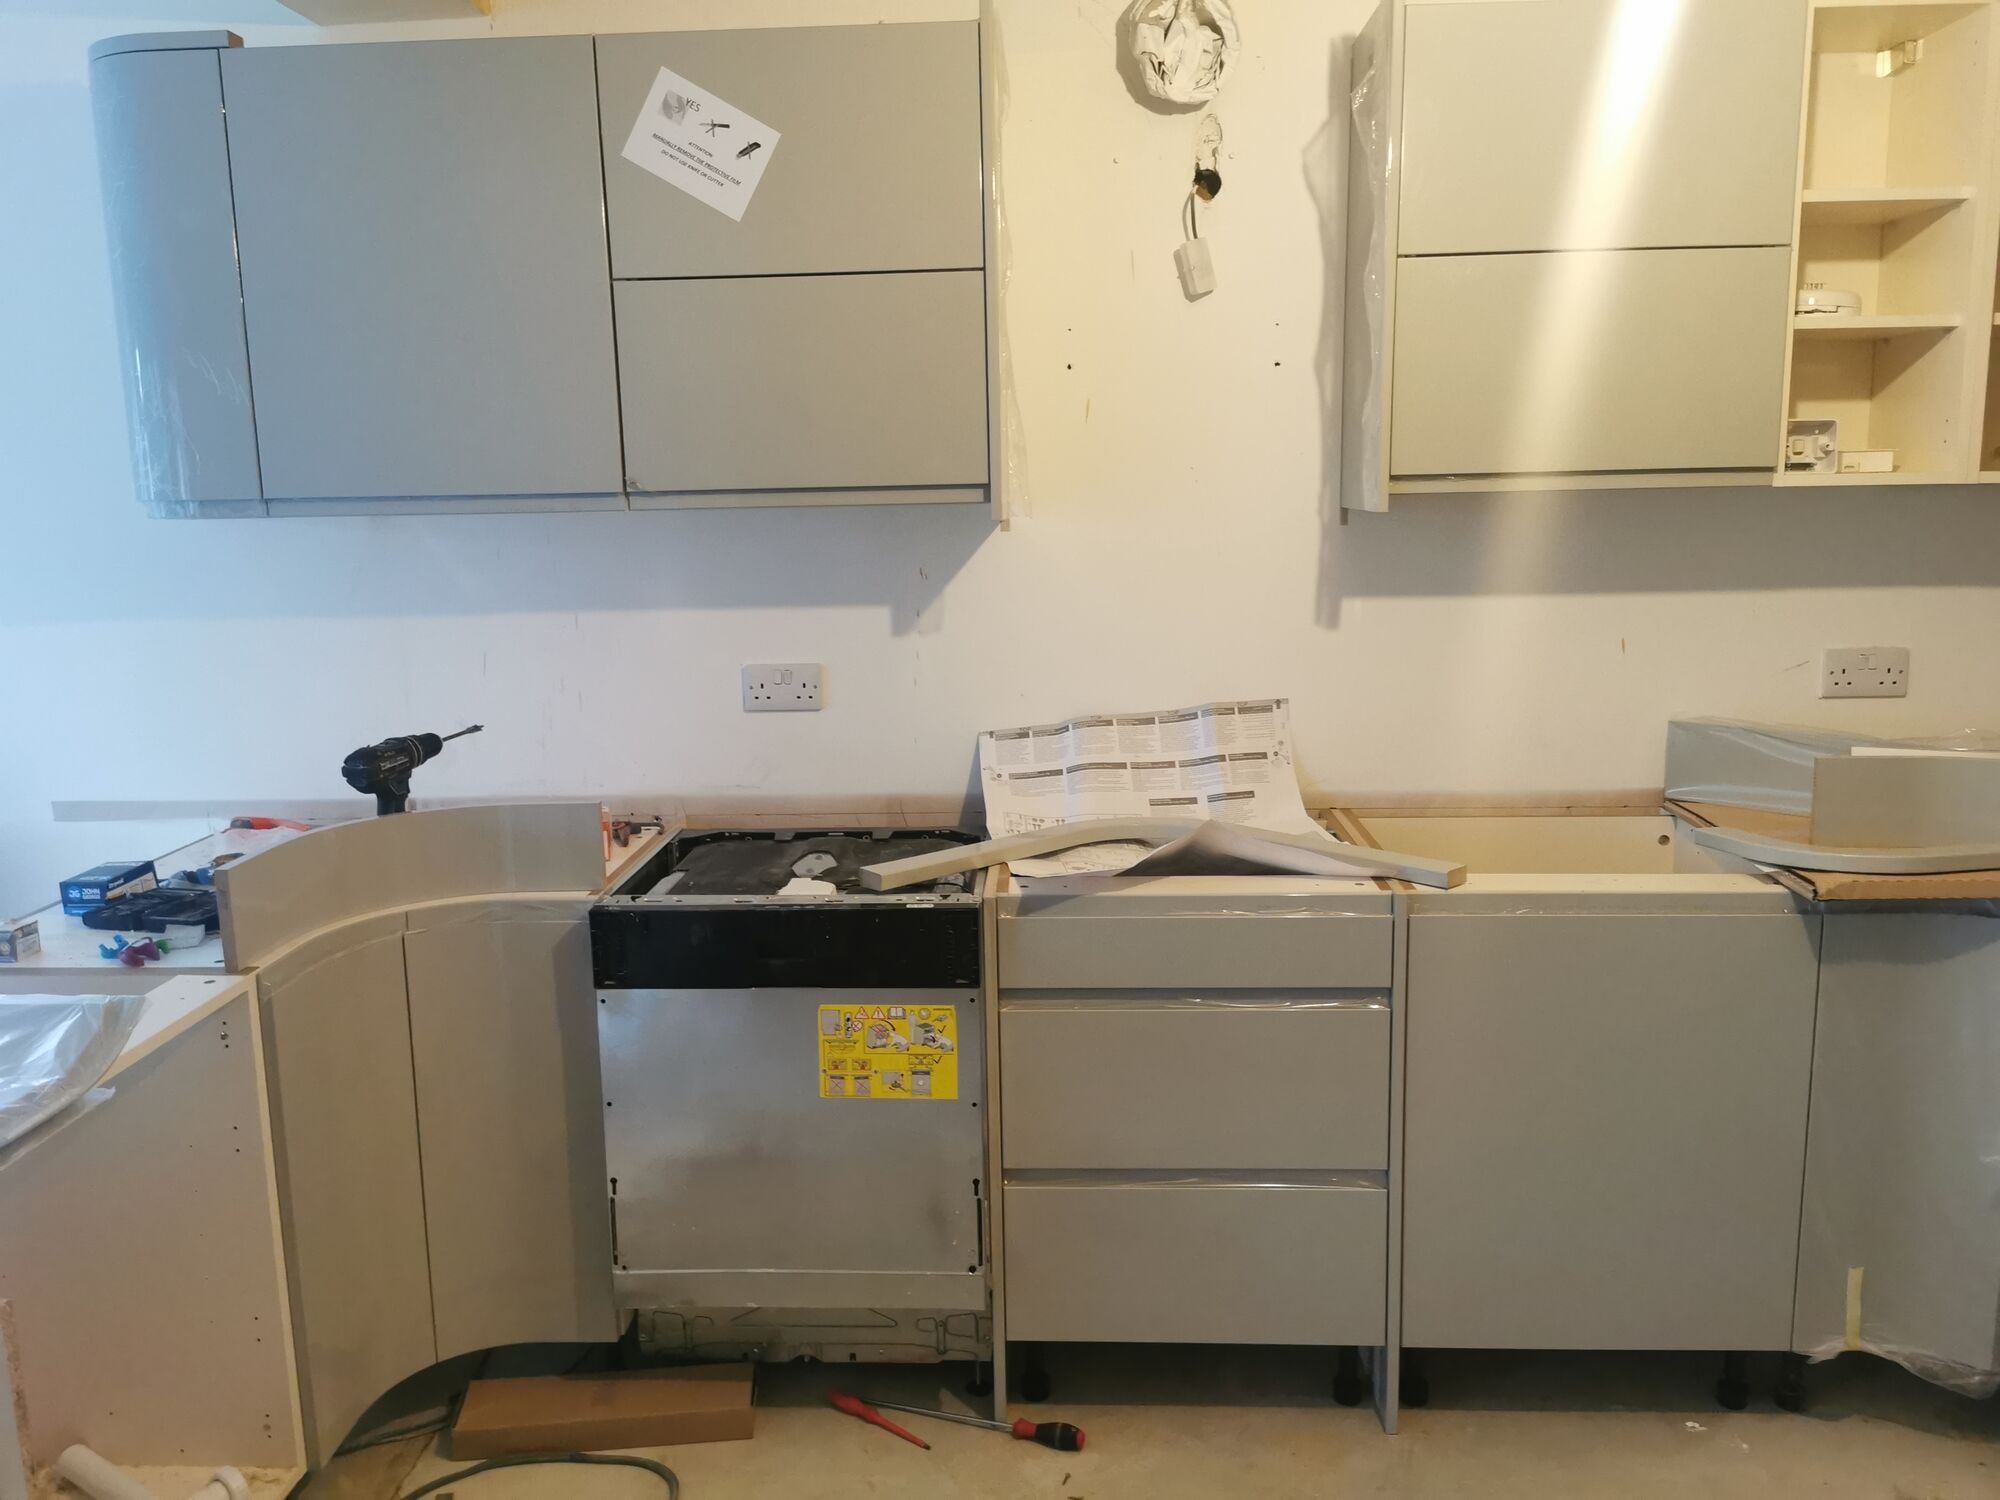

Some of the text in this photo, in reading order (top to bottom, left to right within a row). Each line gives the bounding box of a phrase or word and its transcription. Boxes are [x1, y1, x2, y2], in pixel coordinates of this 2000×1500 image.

[685, 97, 702, 113] YES
[688, 142, 713, 158] ATTENTION
[668, 153, 678, 161] NOT
[687, 164, 700, 174] KNIFE
[707, 175, 724, 187] CUTTER
[676, 146, 695, 159] REMOVE
[695, 157, 705, 165] THE
[704, 162, 730, 179] PROTECTIVE
[729, 176, 741, 186] FILM
